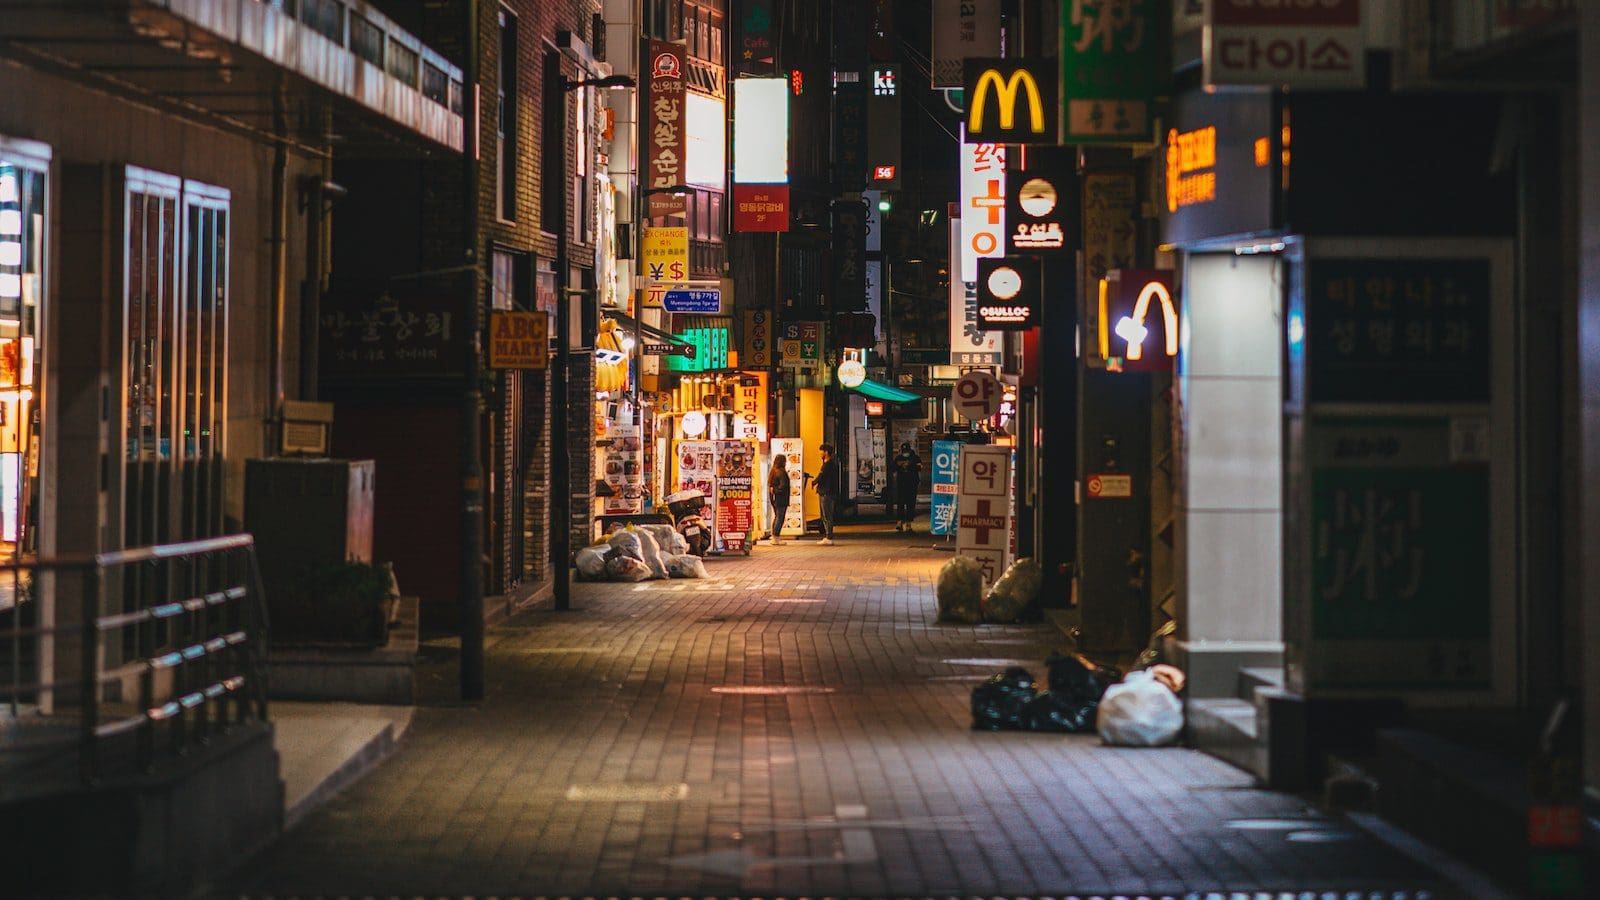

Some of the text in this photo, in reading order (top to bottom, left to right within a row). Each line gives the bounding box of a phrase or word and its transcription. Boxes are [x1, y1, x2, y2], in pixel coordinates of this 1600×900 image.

[1220, 37, 1353, 69] 다이소
[651, 82, 684, 94] 신의주
[874, 71, 896, 88] kt
[496, 316, 543, 339] ABC
[496, 341, 542, 355] MART
[957, 378, 994, 415] 약
[743, 387, 758, 438] 따라오뎅
[936, 452, 959, 482] 약
[973, 461, 998, 488] 약
[962, 518, 1004, 526] PHARMACY
